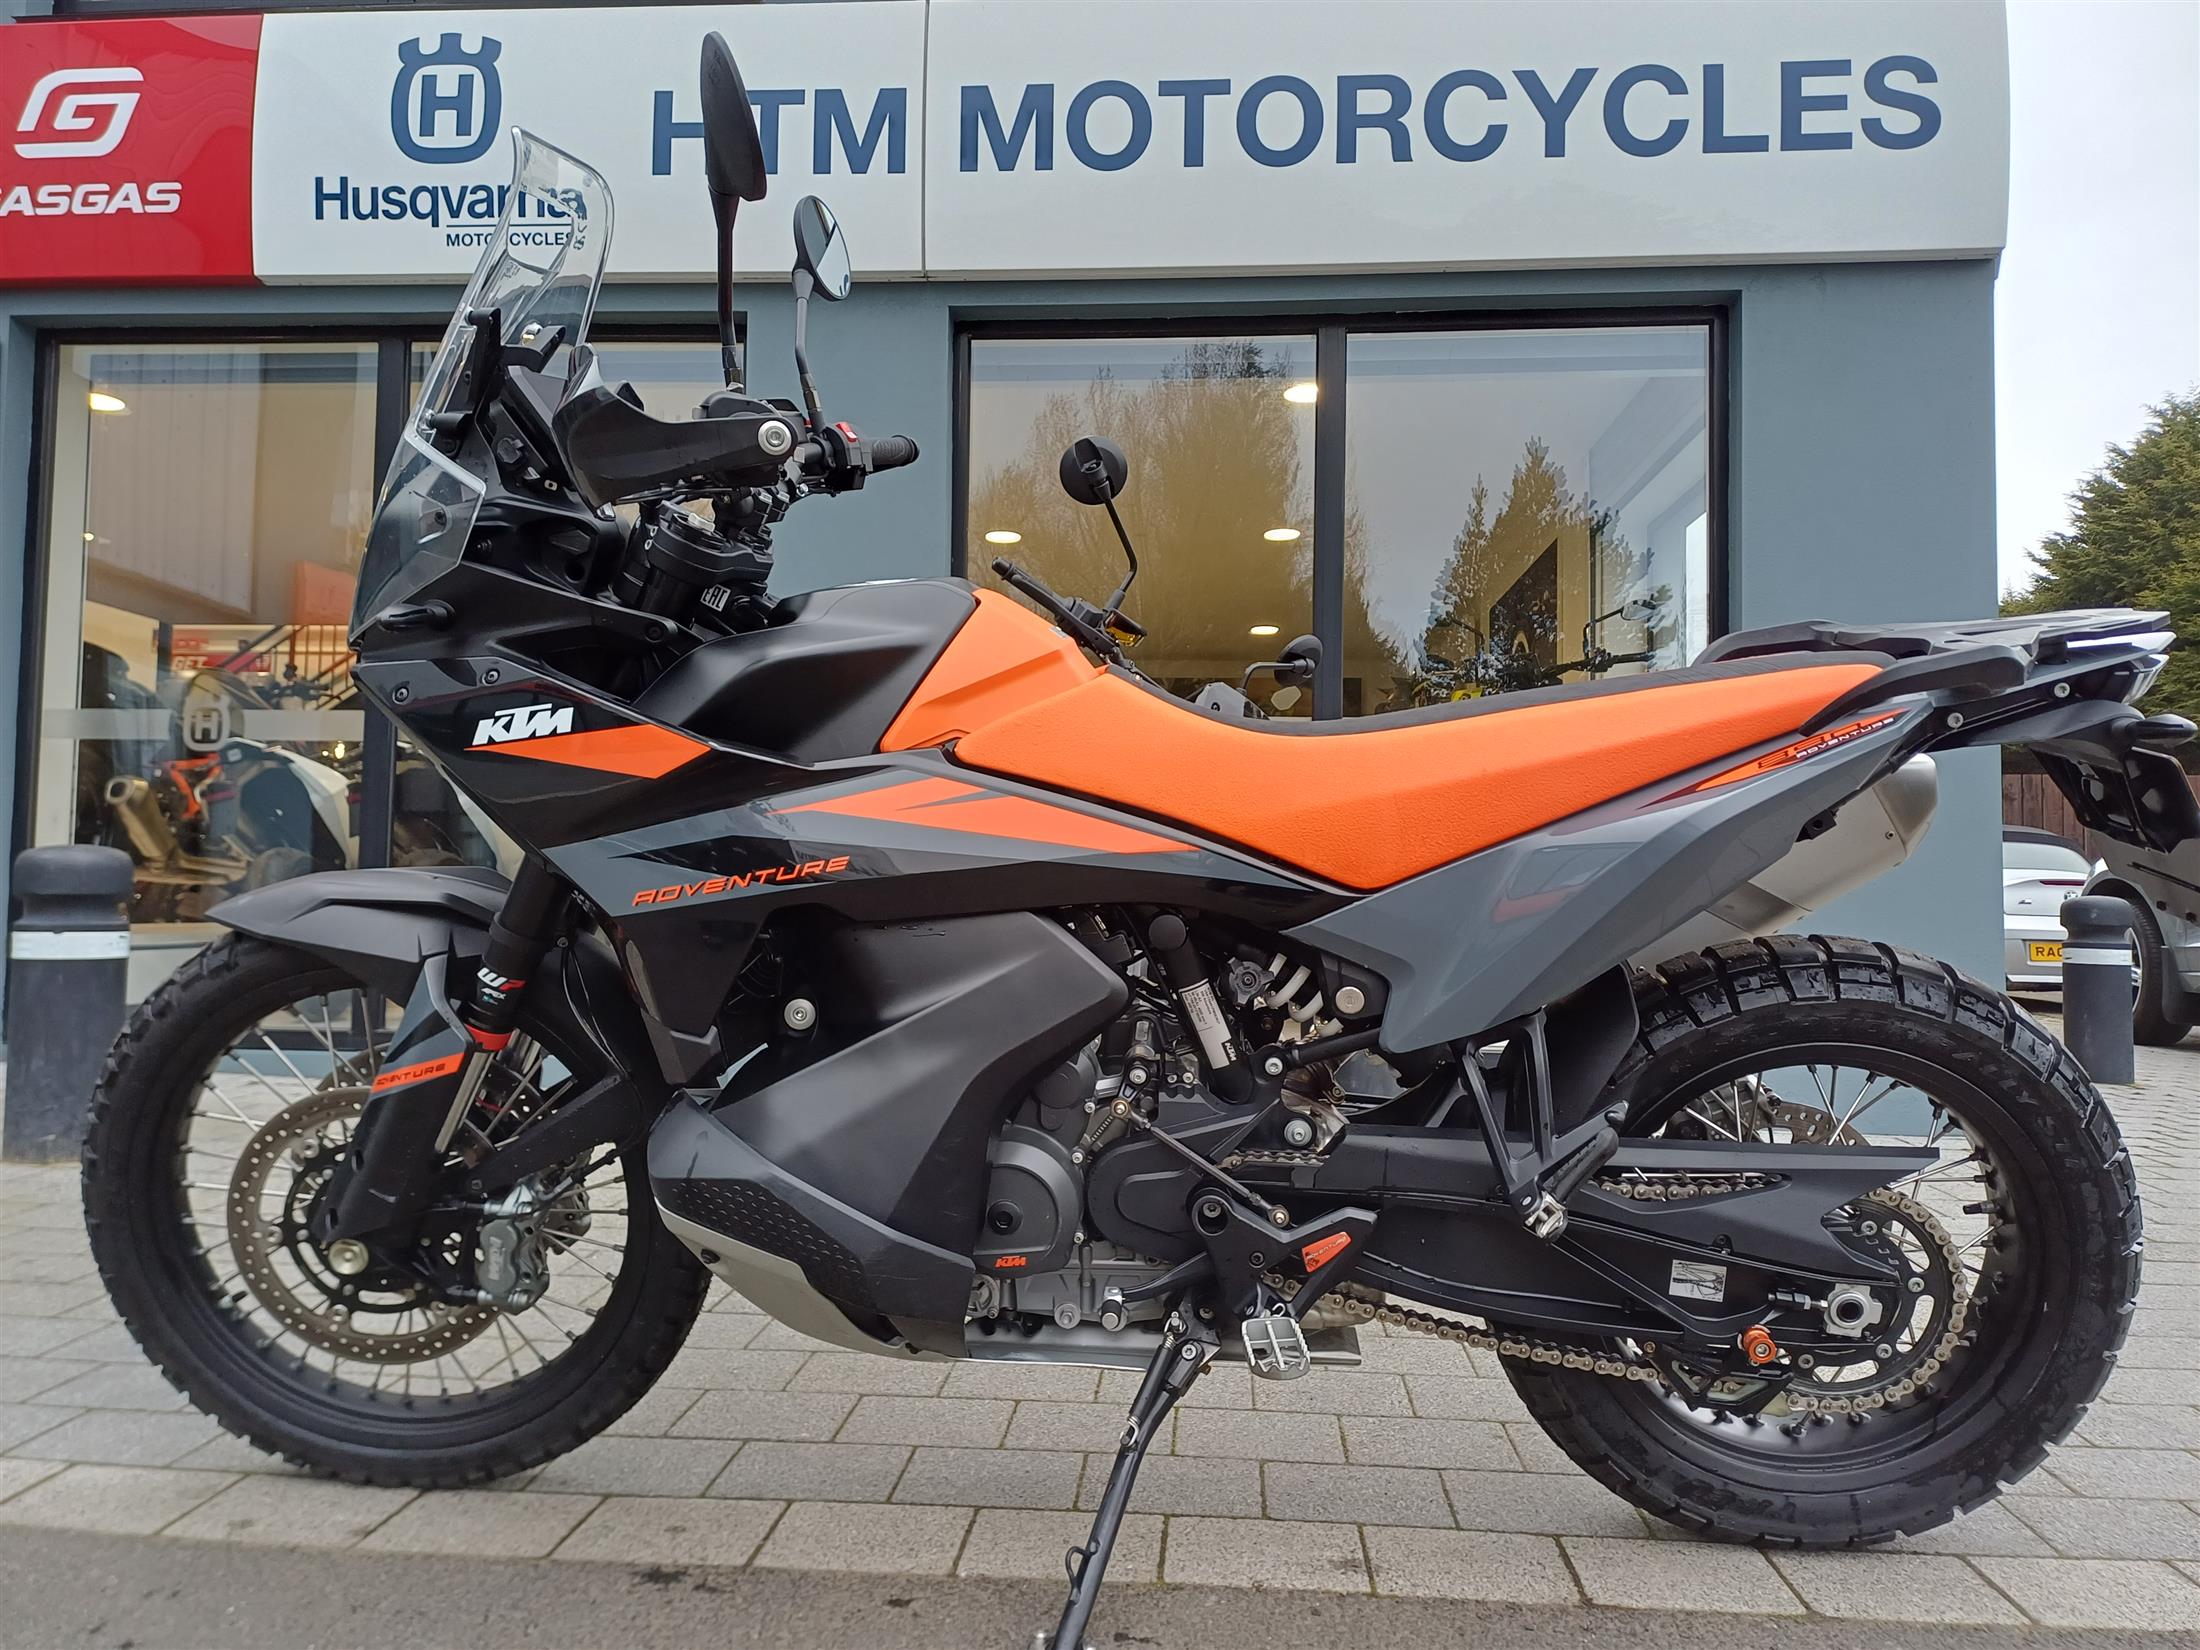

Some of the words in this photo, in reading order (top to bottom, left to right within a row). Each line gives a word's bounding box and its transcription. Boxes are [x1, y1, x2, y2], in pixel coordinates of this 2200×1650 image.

[652, 87, 907, 176] HTM
[959, 55, 1942, 173] MOTORCYCLES
[0, 182, 182, 217] ASGAS
[472, 703, 574, 746] KTM
[1796, 717, 1895, 758] ADVENTURE
[632, 855, 850, 907] ADVENTURE
[995, 1255, 1027, 1268] KTM
